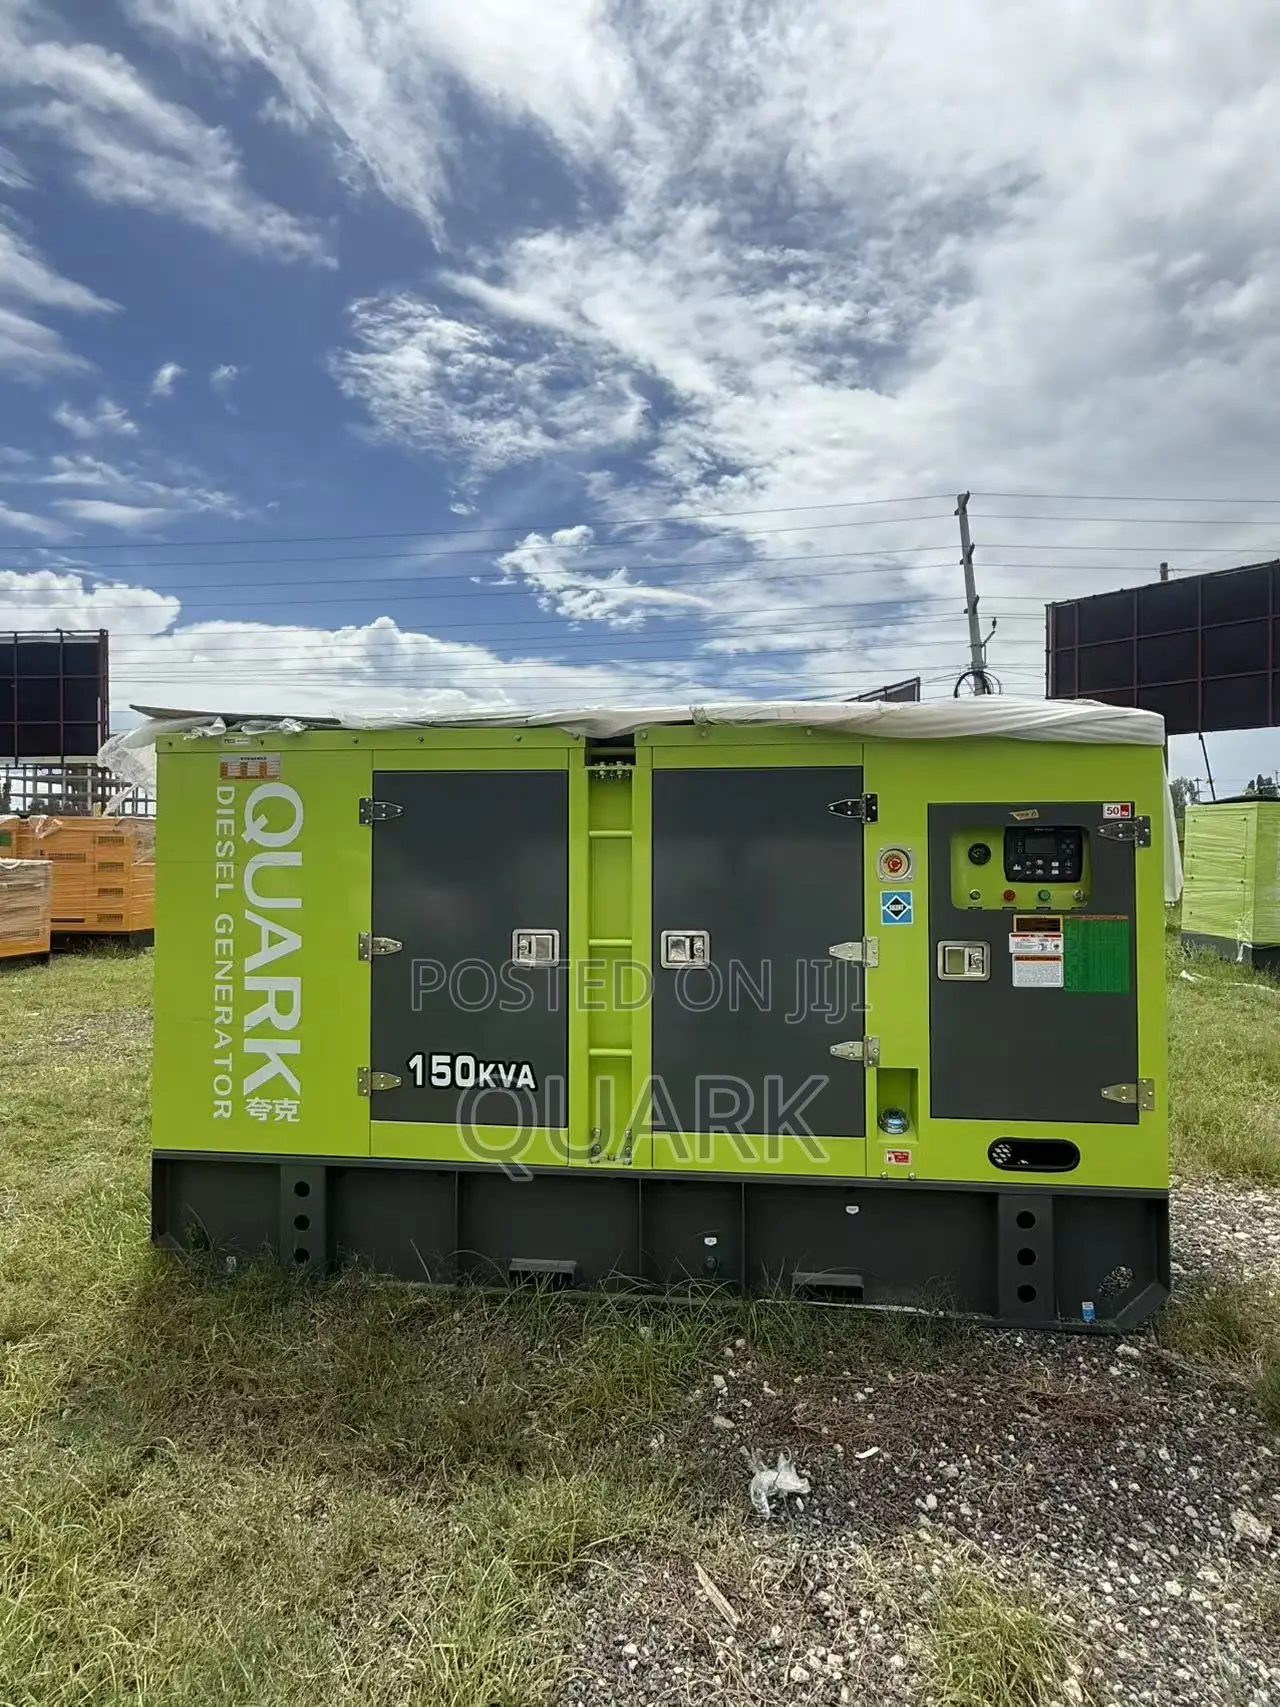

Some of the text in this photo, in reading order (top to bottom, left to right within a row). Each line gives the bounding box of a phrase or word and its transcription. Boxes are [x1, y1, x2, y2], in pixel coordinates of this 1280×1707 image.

[1106, 806, 1119, 815] 50
[213, 786, 235, 1120] DIESEL GENERATOR
[241, 782, 303, 1096] QUARK
[408, 1054, 536, 1090] 150KVA
[246, 1098, 300, 1122] 夸克
